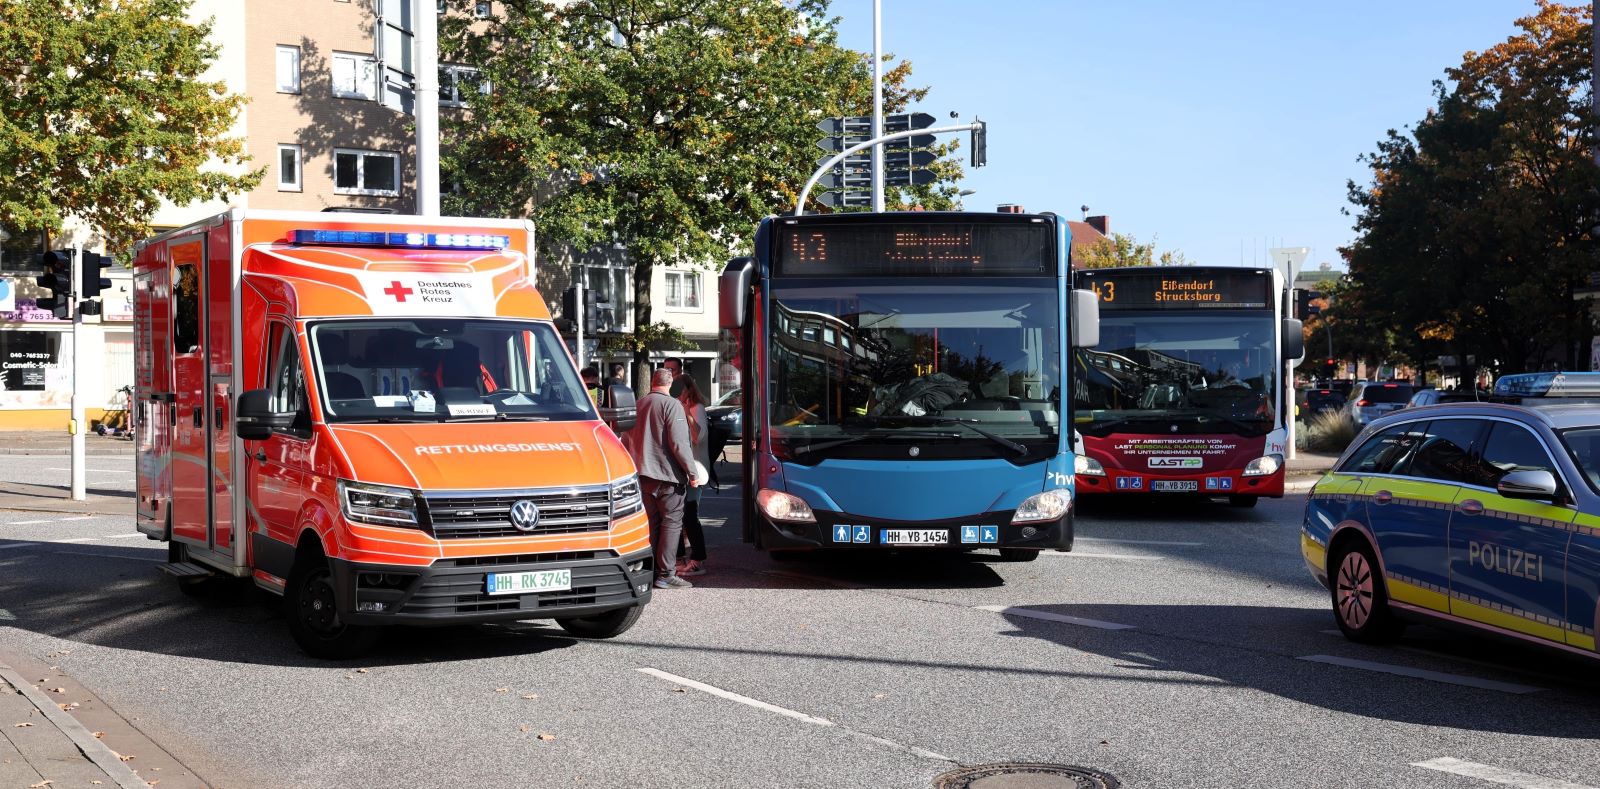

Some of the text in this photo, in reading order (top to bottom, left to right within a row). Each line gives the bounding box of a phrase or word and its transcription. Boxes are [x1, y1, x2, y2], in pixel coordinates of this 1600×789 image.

[1091, 280, 1214, 302] 43 Eißendorf
[1155, 292, 1221, 302] Strucksbarg
[415, 442, 582, 456] RETTUNGSDIENST
[1155, 481, 1197, 490] HH YB 3915
[887, 531, 948, 542] HH YB 1454
[1469, 541, 1542, 582] POLIZEI
[496, 572, 569, 590] HH RK 3745
